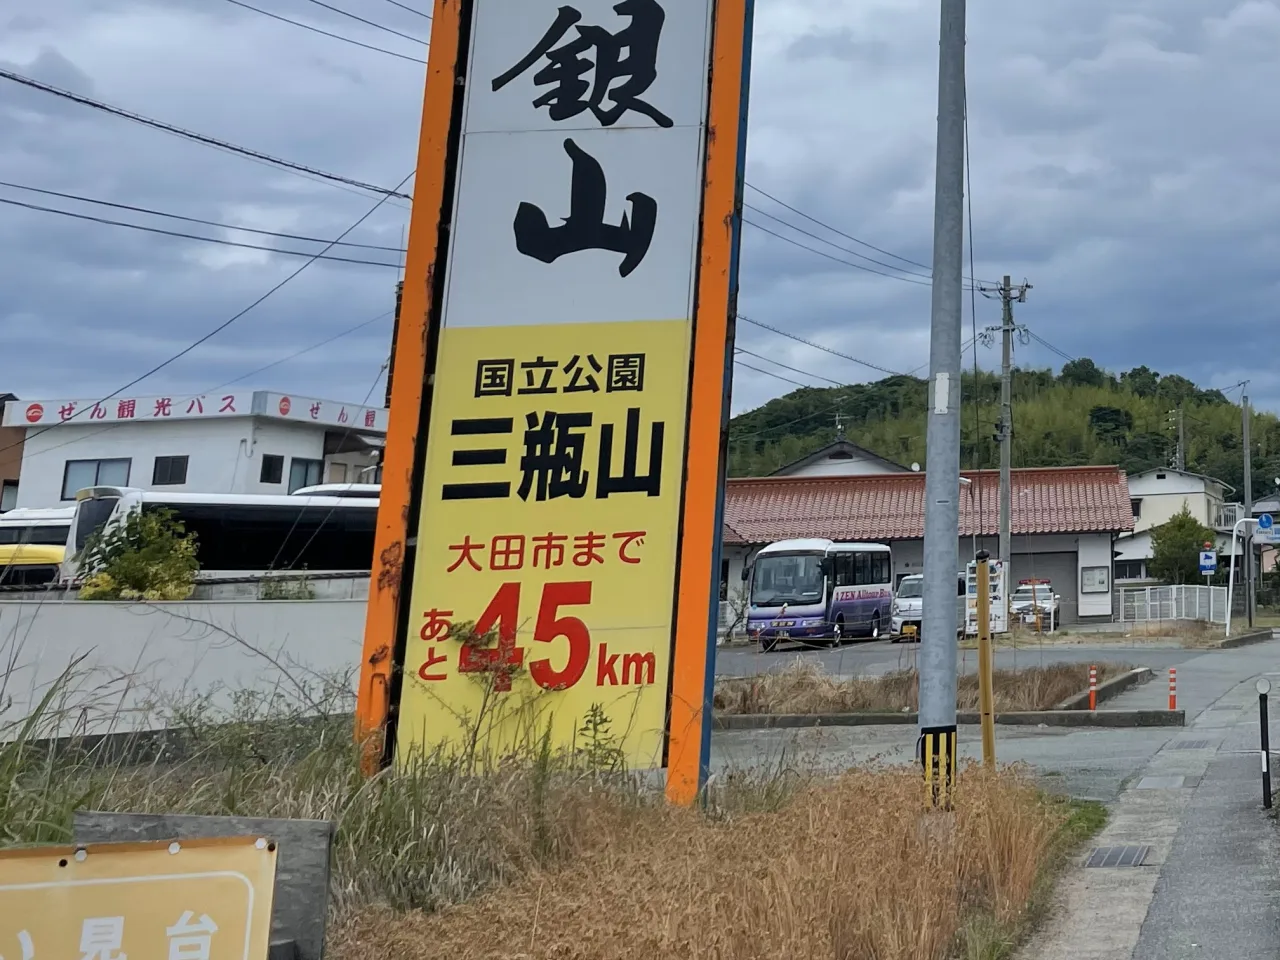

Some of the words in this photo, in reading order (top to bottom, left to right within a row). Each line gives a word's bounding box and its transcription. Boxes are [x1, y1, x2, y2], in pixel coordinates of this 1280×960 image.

[474, 353, 646, 398] 国立公園
[58, 395, 236, 421] ぜん観光バス
[442, 407, 665, 502] 三瓶山
[447, 531, 647, 573] 大田市まで
[839, 590, 856, 601] ZEN
[418, 607, 454, 681] あと
